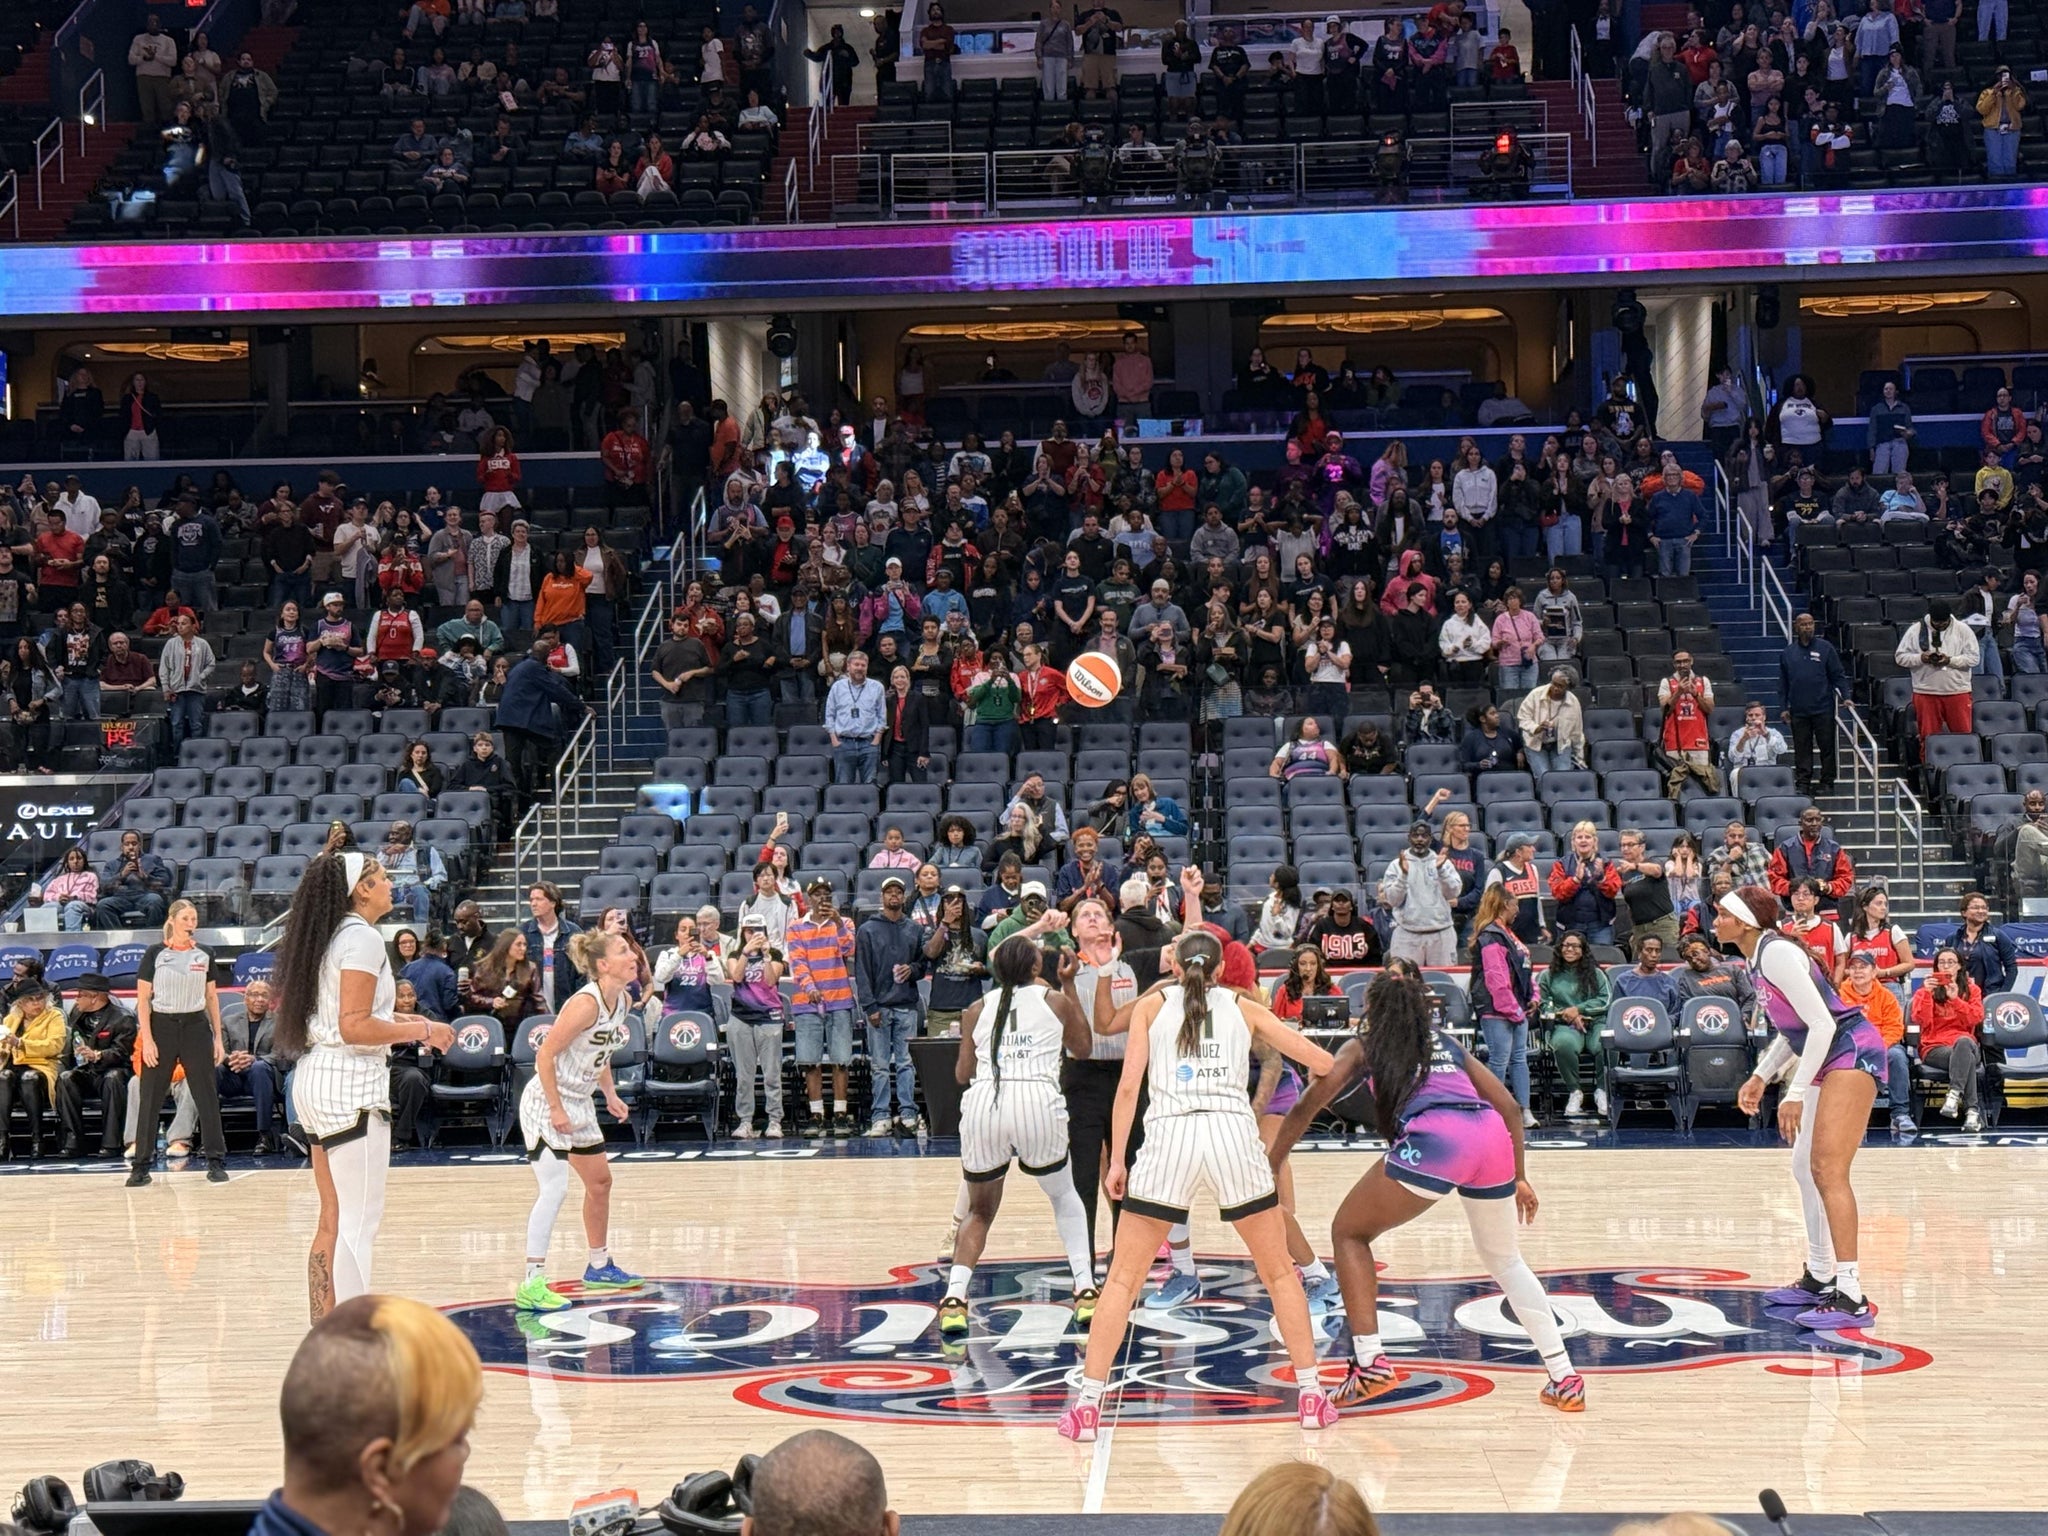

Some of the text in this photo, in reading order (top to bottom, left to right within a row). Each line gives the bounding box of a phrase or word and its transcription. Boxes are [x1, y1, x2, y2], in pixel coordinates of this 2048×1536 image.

[389, 627, 397, 639] 0
[1074, 669, 1104, 698] Wilson
[1299, 751, 1317, 760] 44
[38, 805, 95, 817] LEXUS
[0, 822, 99, 840] AUL
[1512, 880, 1537, 894] RISE
[1321, 932, 1369, 960] 1913
[45, 959, 98, 972] VAULTS
[680, 975, 698, 987] 22
[745, 970, 763, 983] 22
[1001, 1034, 1033, 1046] LLIAMS
[1196, 1066, 1229, 1079] AT&T
[449, 1148, 820, 1163] Deloie.
